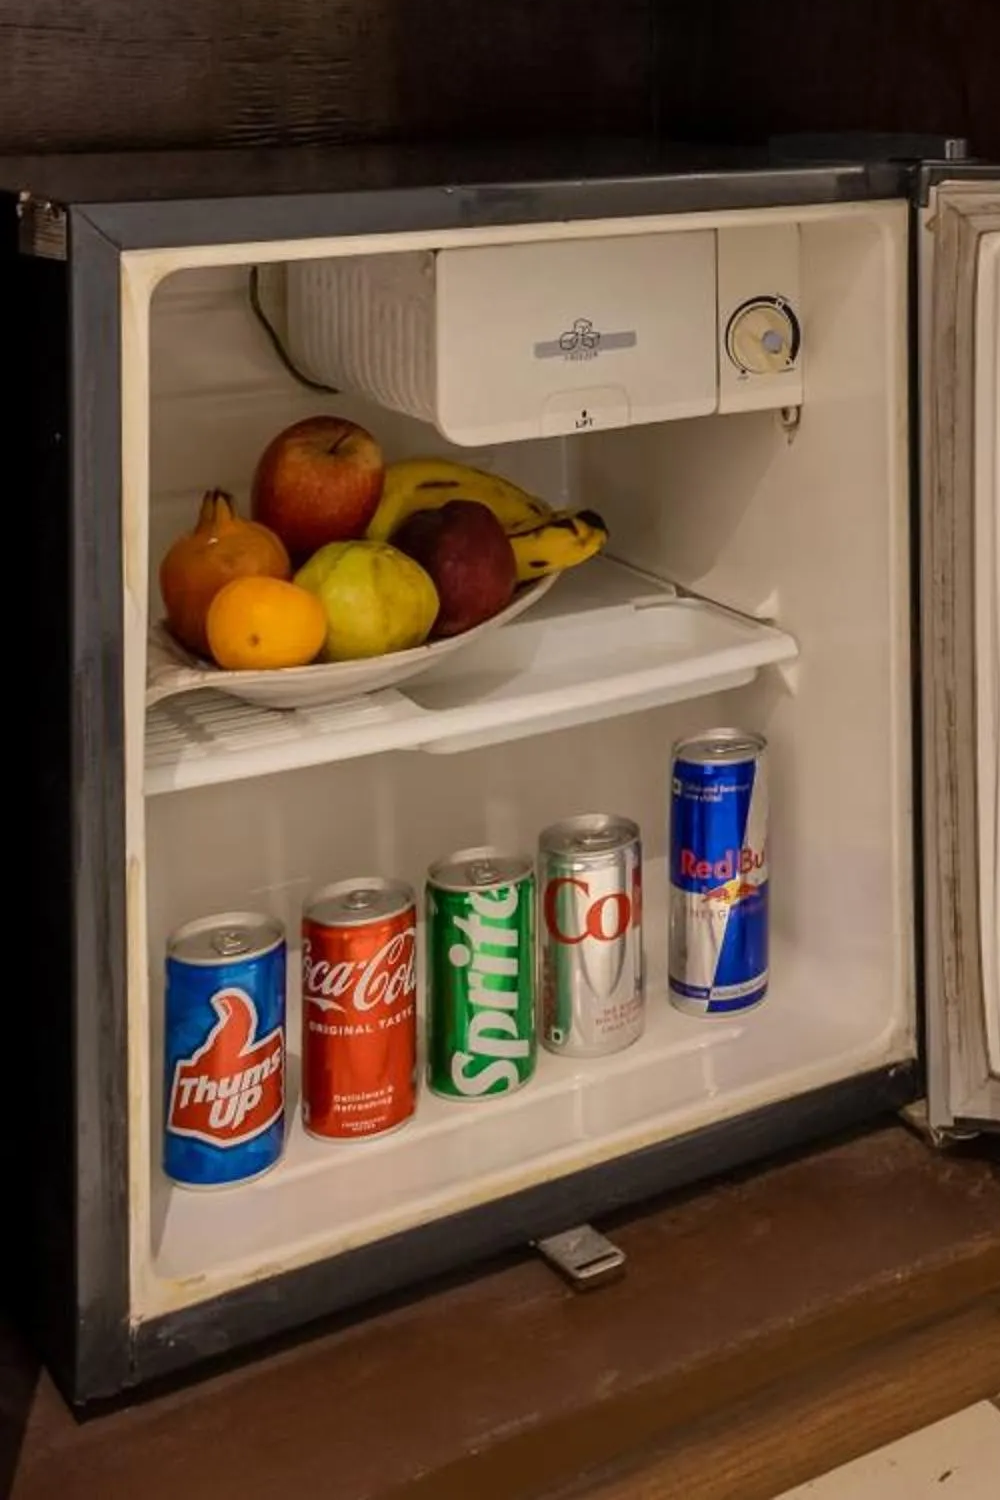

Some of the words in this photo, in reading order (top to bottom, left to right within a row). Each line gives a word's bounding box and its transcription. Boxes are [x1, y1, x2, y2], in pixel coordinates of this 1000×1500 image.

[682, 850, 734, 879] Red
[449, 885, 529, 1096] Sprite
[179, 1048, 281, 1109] Thums
